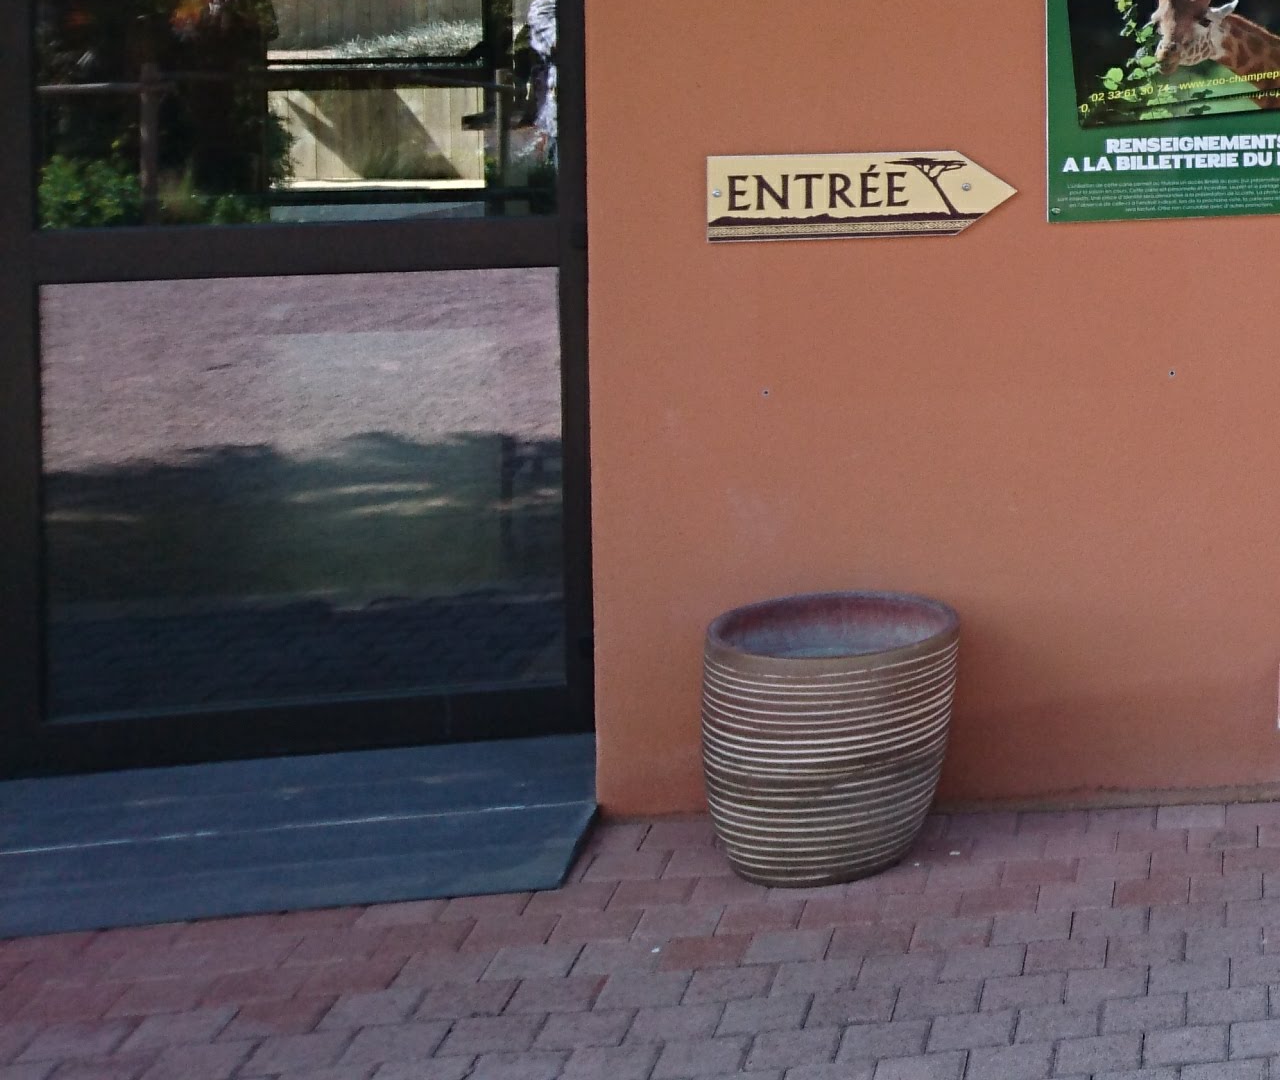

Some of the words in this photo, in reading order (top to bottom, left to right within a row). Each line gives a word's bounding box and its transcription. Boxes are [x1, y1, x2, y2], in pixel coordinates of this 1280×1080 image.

[1091, 92, 1105, 103] 02
[1122, 88, 1137, 99] 61
[1062, 157, 1079, 172] A
[1083, 156, 1112, 171] LA
[1115, 152, 1239, 170] BILLETTERIE
[1243, 151, 1272, 167] DU
[727, 164, 909, 211] ENTRÉE
